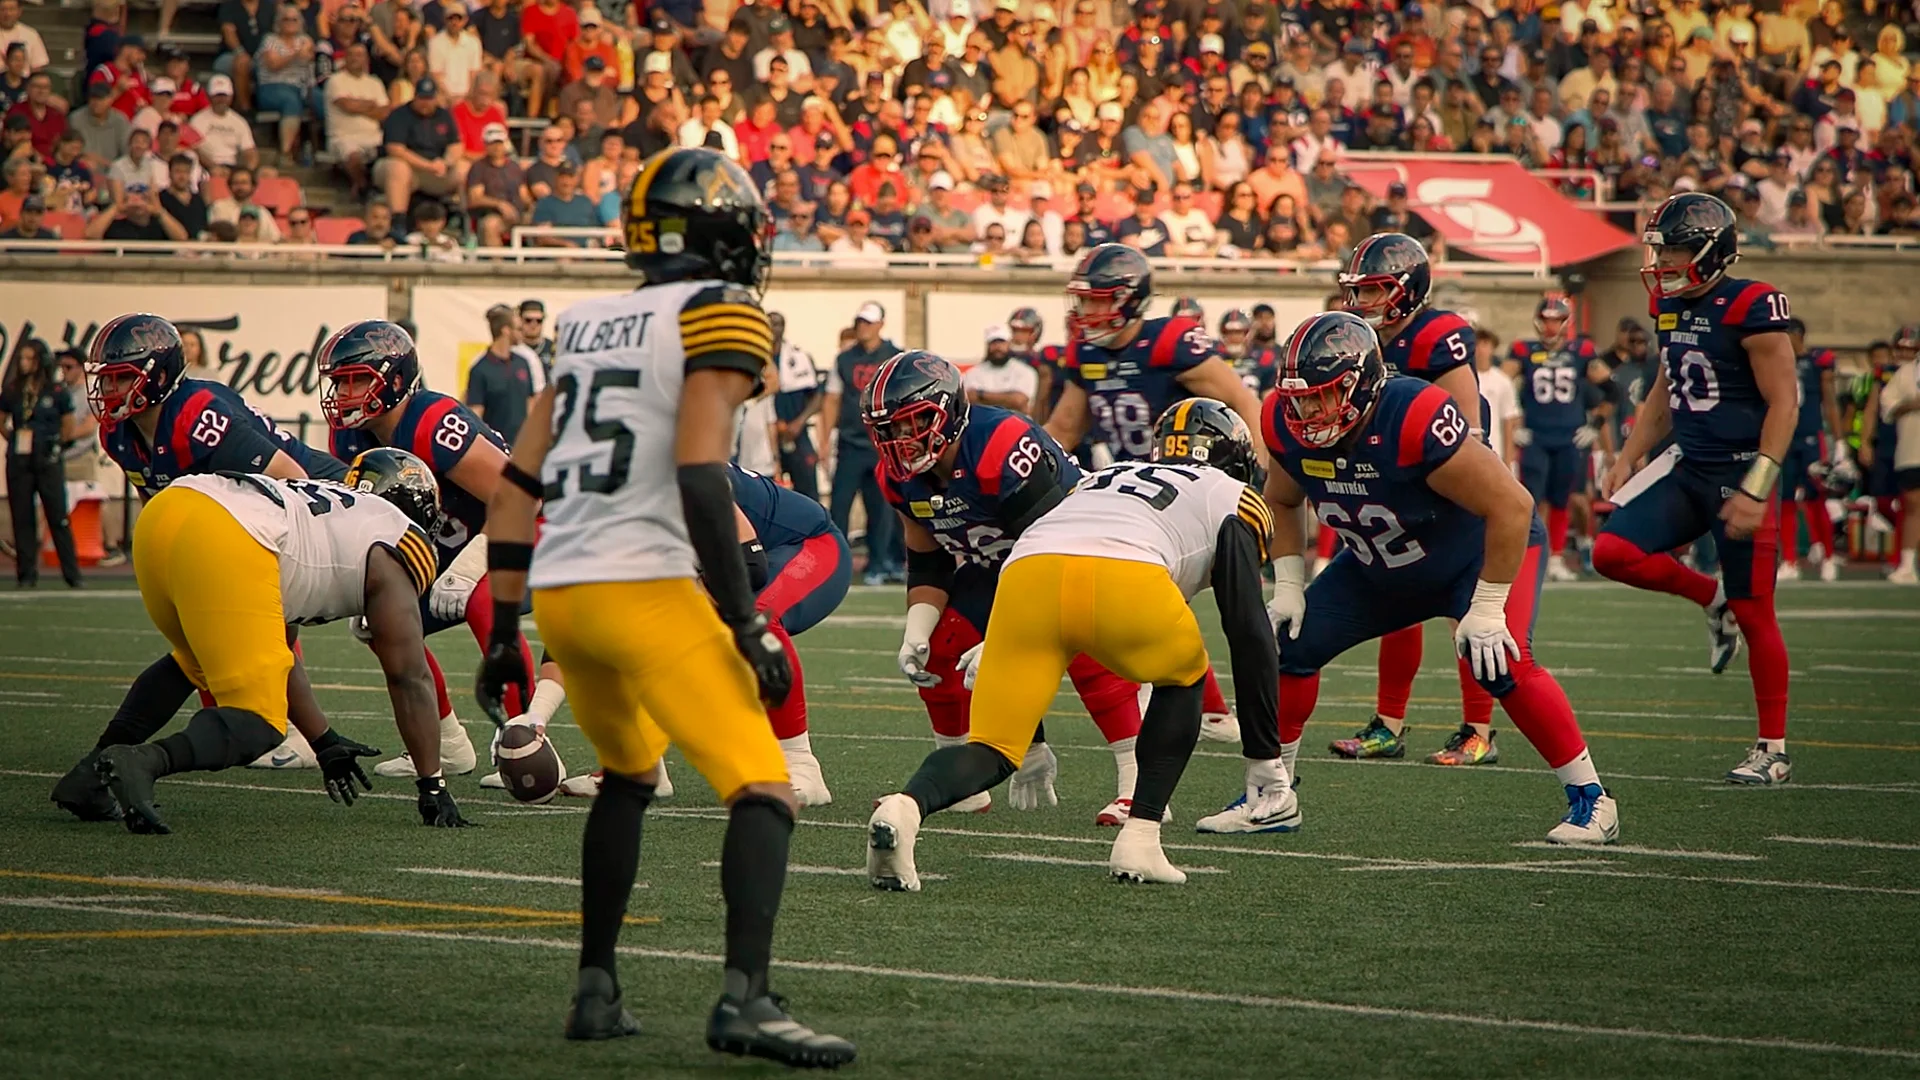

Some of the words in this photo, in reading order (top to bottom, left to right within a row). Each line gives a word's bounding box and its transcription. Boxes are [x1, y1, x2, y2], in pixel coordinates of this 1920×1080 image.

[627, 220, 657, 253] 25
[1767, 293, 1790, 321] 10
[1446, 332, 1468, 361] 5
[1532, 366, 1577, 404] 65
[1660, 346, 1720, 412] 10
[191, 408, 229, 447] 52
[435, 412, 470, 452] 68
[544, 369, 641, 500] 25
[1431, 403, 1465, 447] 62
[1008, 436, 1041, 478] 66
[1164, 434, 1190, 457] 95
[1354, 472, 1380, 480] SPORTS
[1317, 501, 1426, 569] 62
